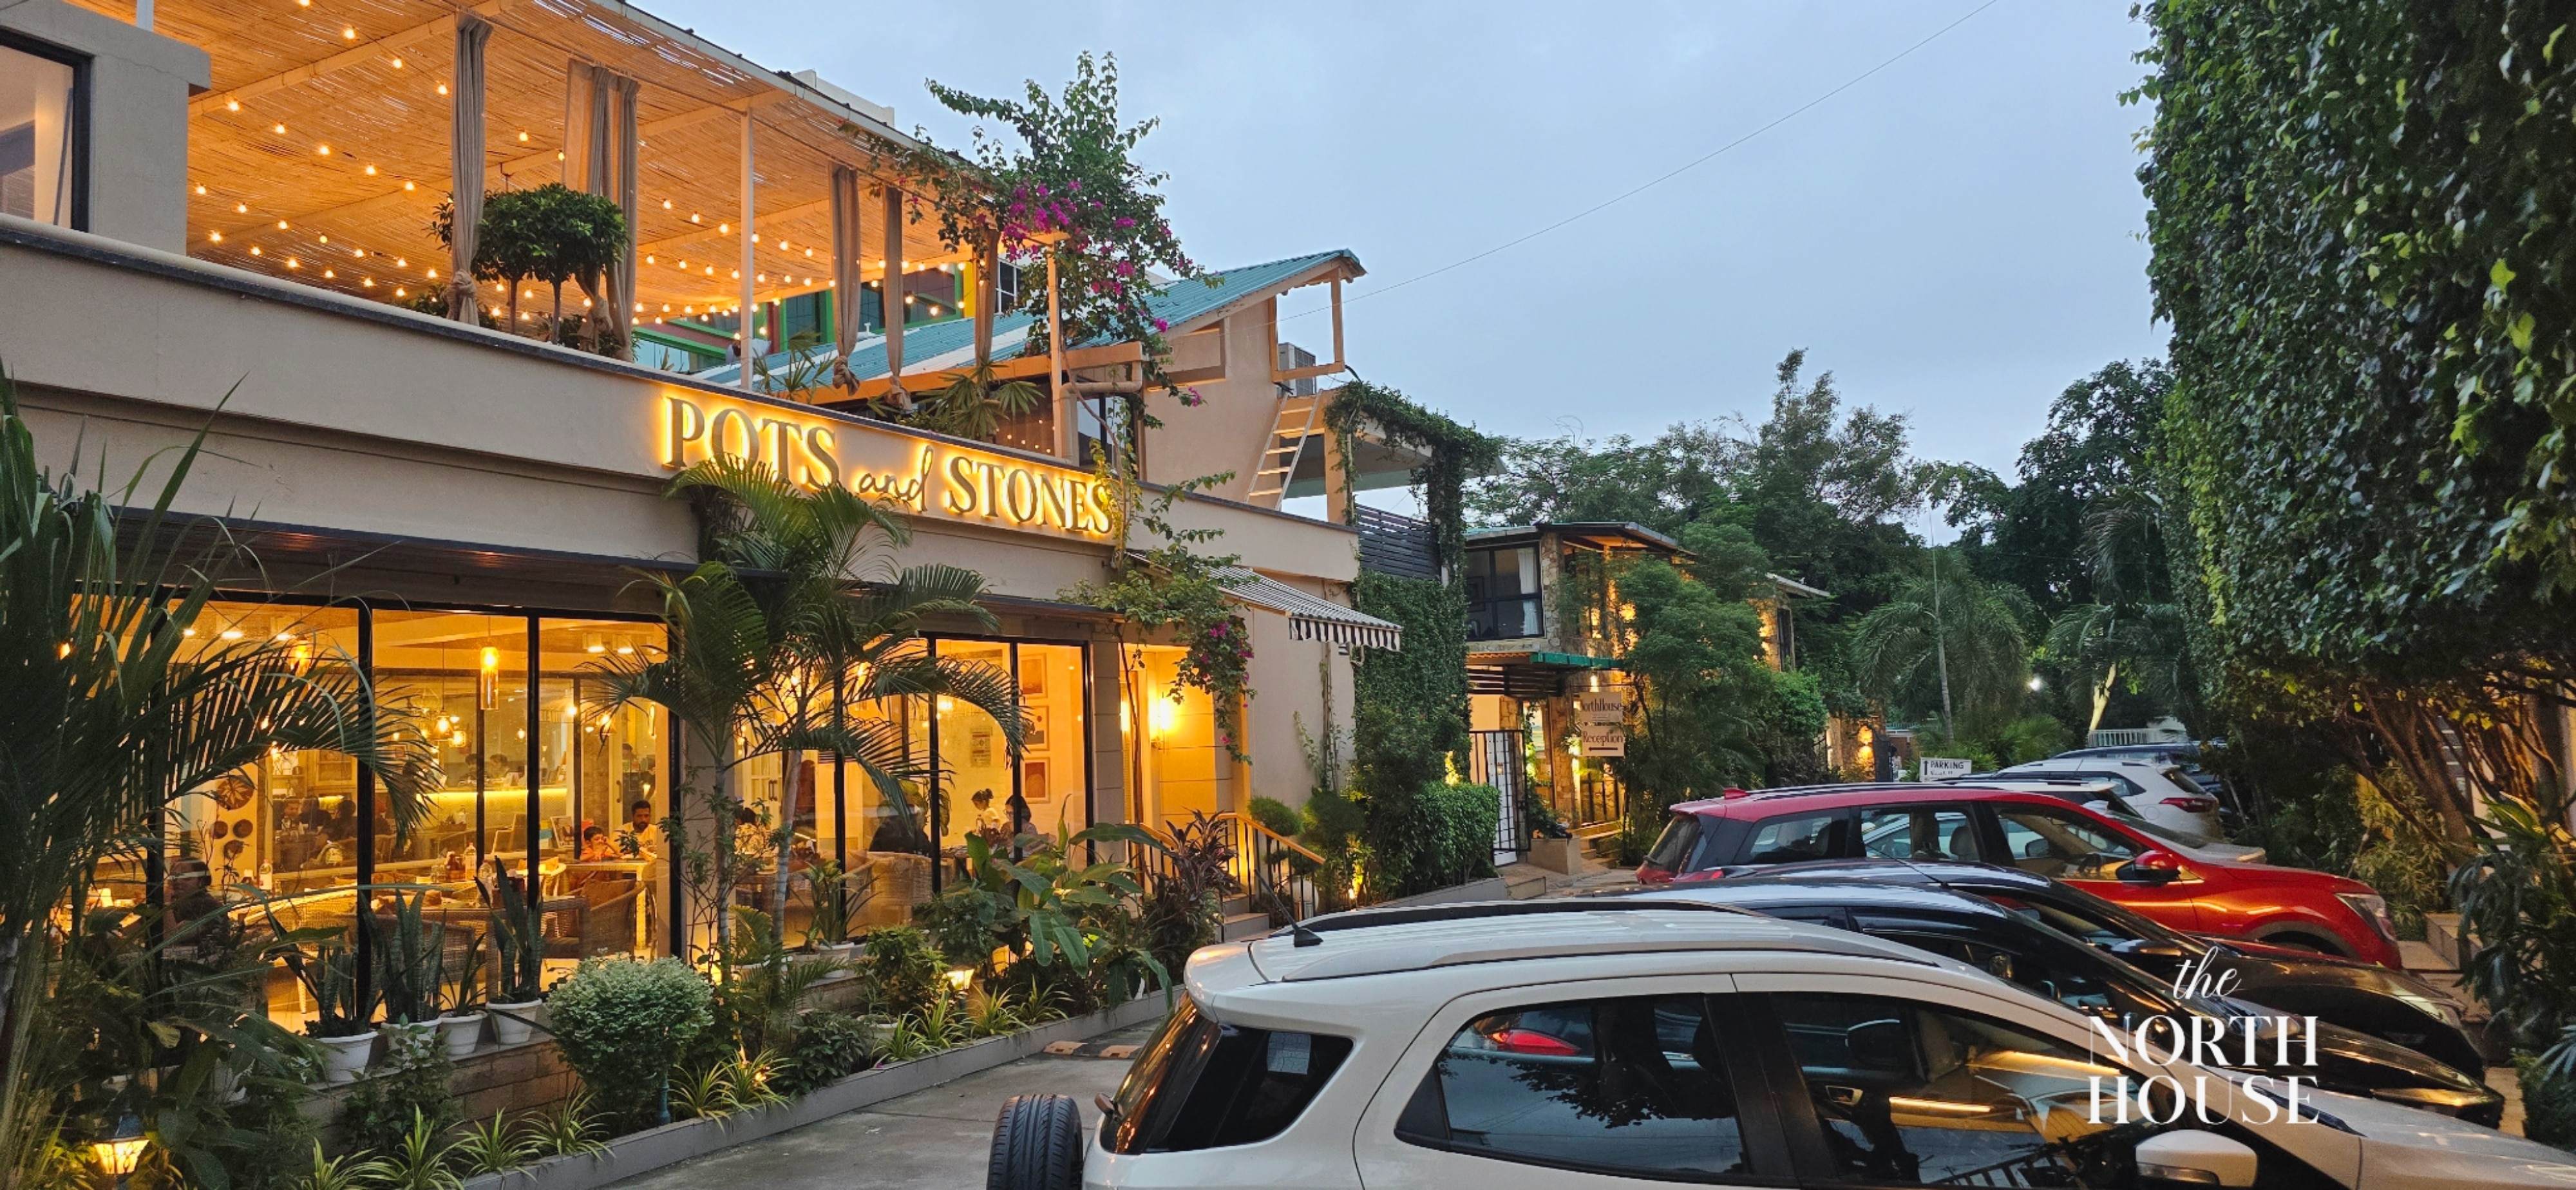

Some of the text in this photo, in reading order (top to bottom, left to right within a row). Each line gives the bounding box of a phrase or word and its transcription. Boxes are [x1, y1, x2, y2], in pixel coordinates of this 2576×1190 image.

[662, 396, 1112, 534] POTS and STONES
[1583, 731, 1623, 746] Reception
[1931, 760, 1964, 769] PARKING
